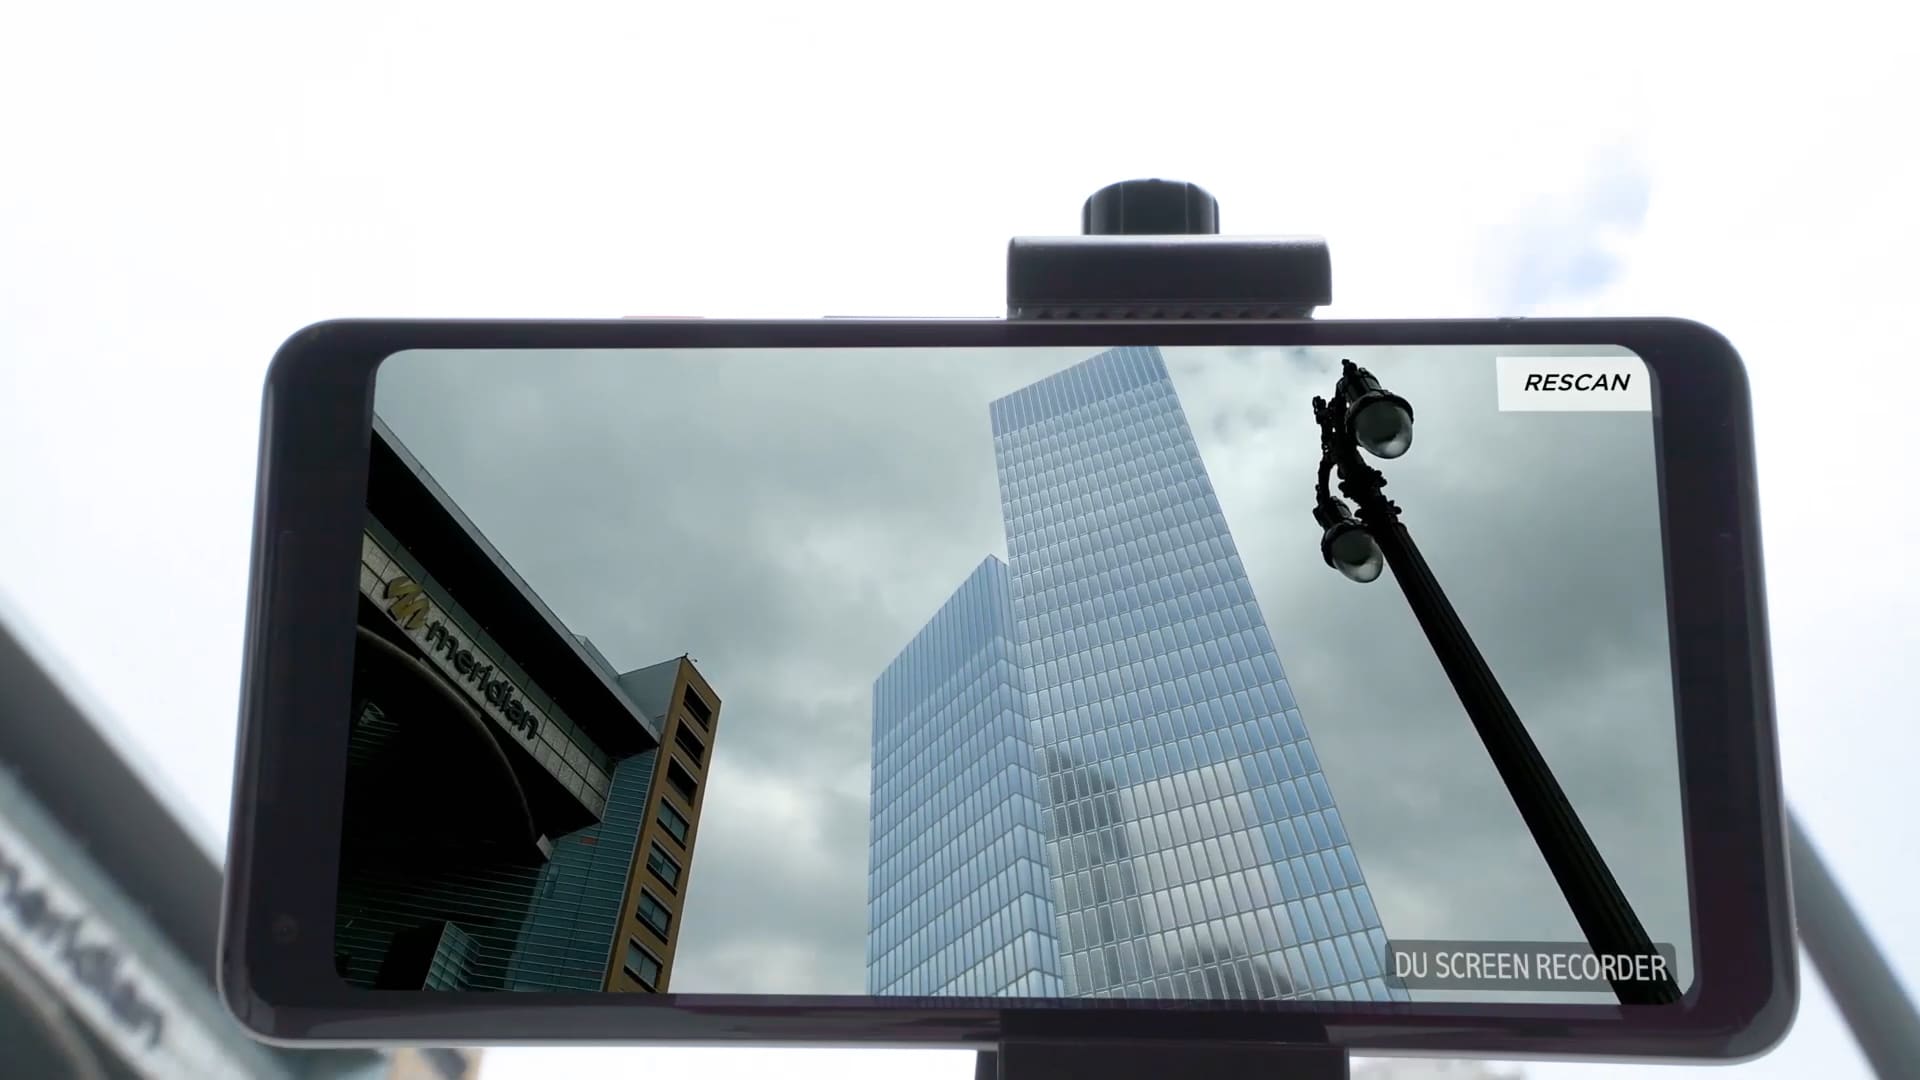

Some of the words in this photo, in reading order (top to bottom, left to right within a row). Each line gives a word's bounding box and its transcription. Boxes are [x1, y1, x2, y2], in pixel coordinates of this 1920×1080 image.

[1524, 373, 1632, 391] RESCAN
[425, 620, 540, 740] meridian
[1395, 951, 1428, 978] DU
[1435, 951, 1530, 979] SCREEN
[1536, 953, 1669, 982] RECORDER
